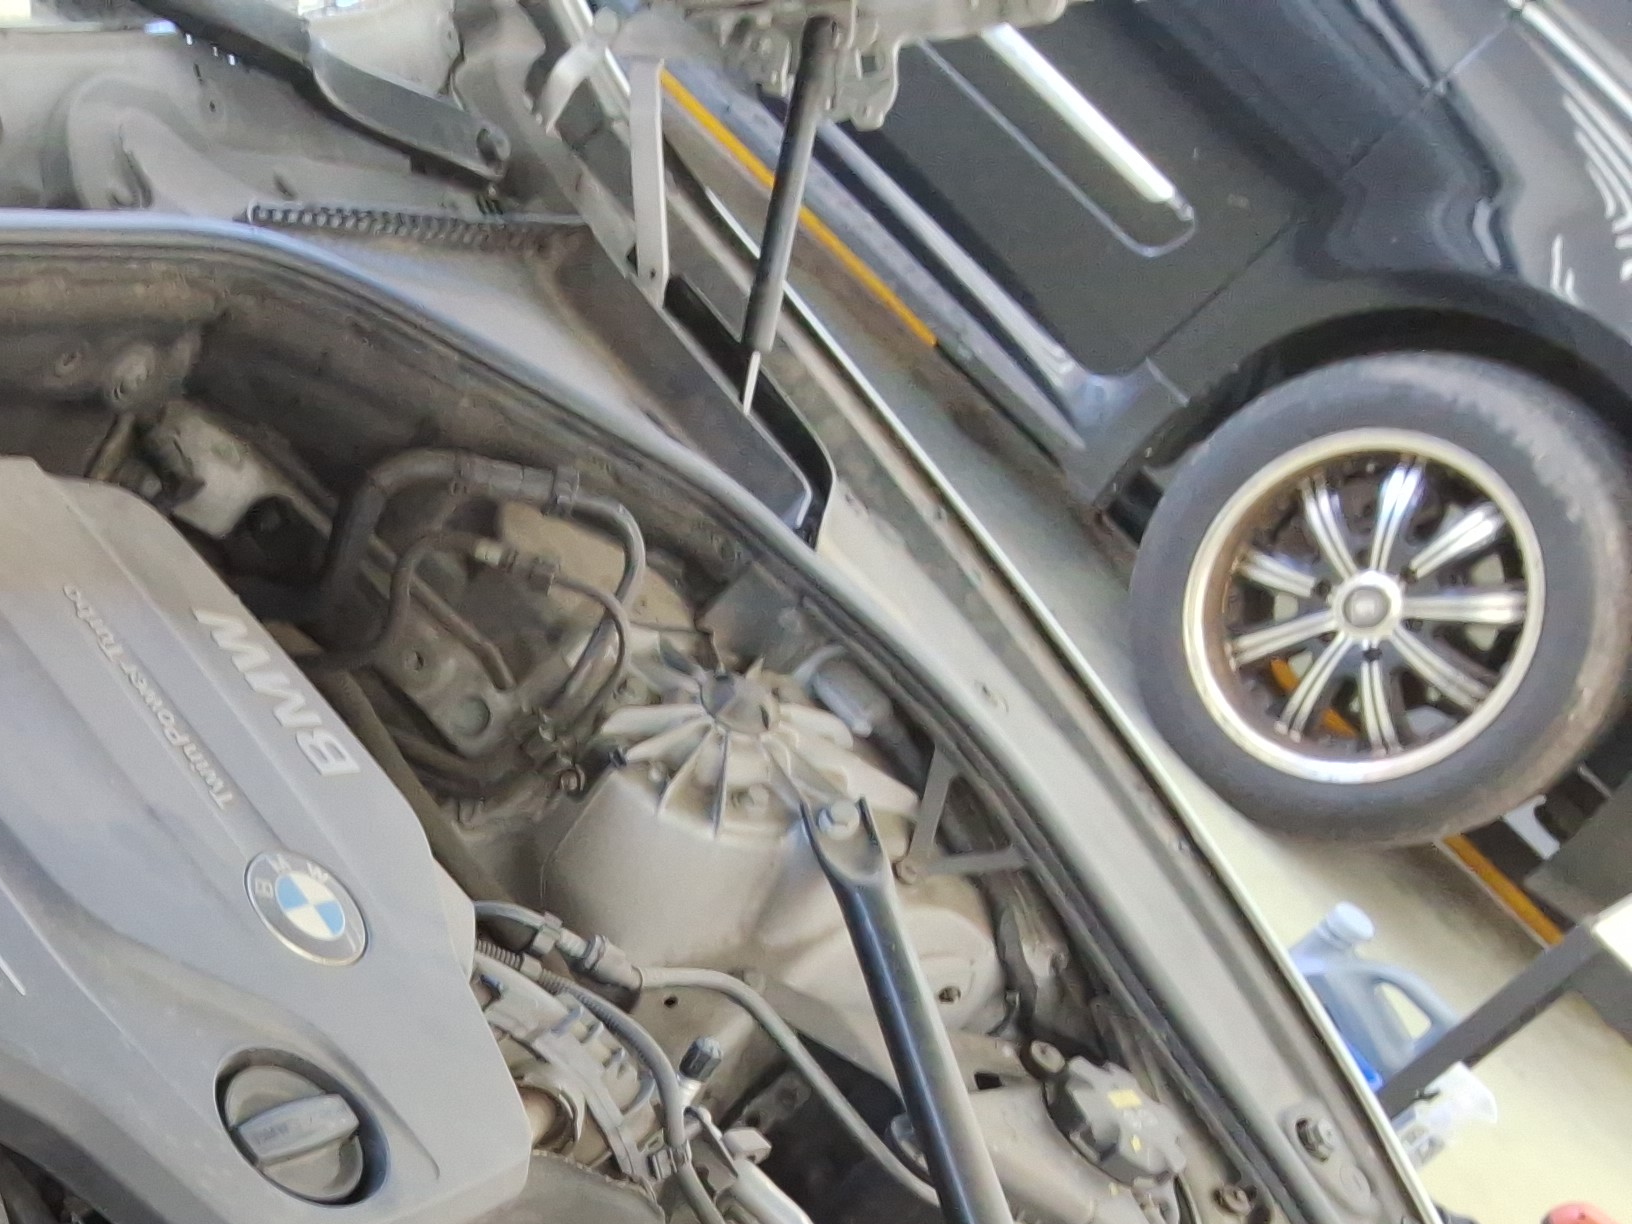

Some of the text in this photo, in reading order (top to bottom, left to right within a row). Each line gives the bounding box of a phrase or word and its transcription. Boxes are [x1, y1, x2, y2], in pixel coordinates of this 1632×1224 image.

[63, 584, 233, 810] TwinPower Turbo
[191, 608, 361, 776] BMW
[254, 853, 329, 899] BMW
